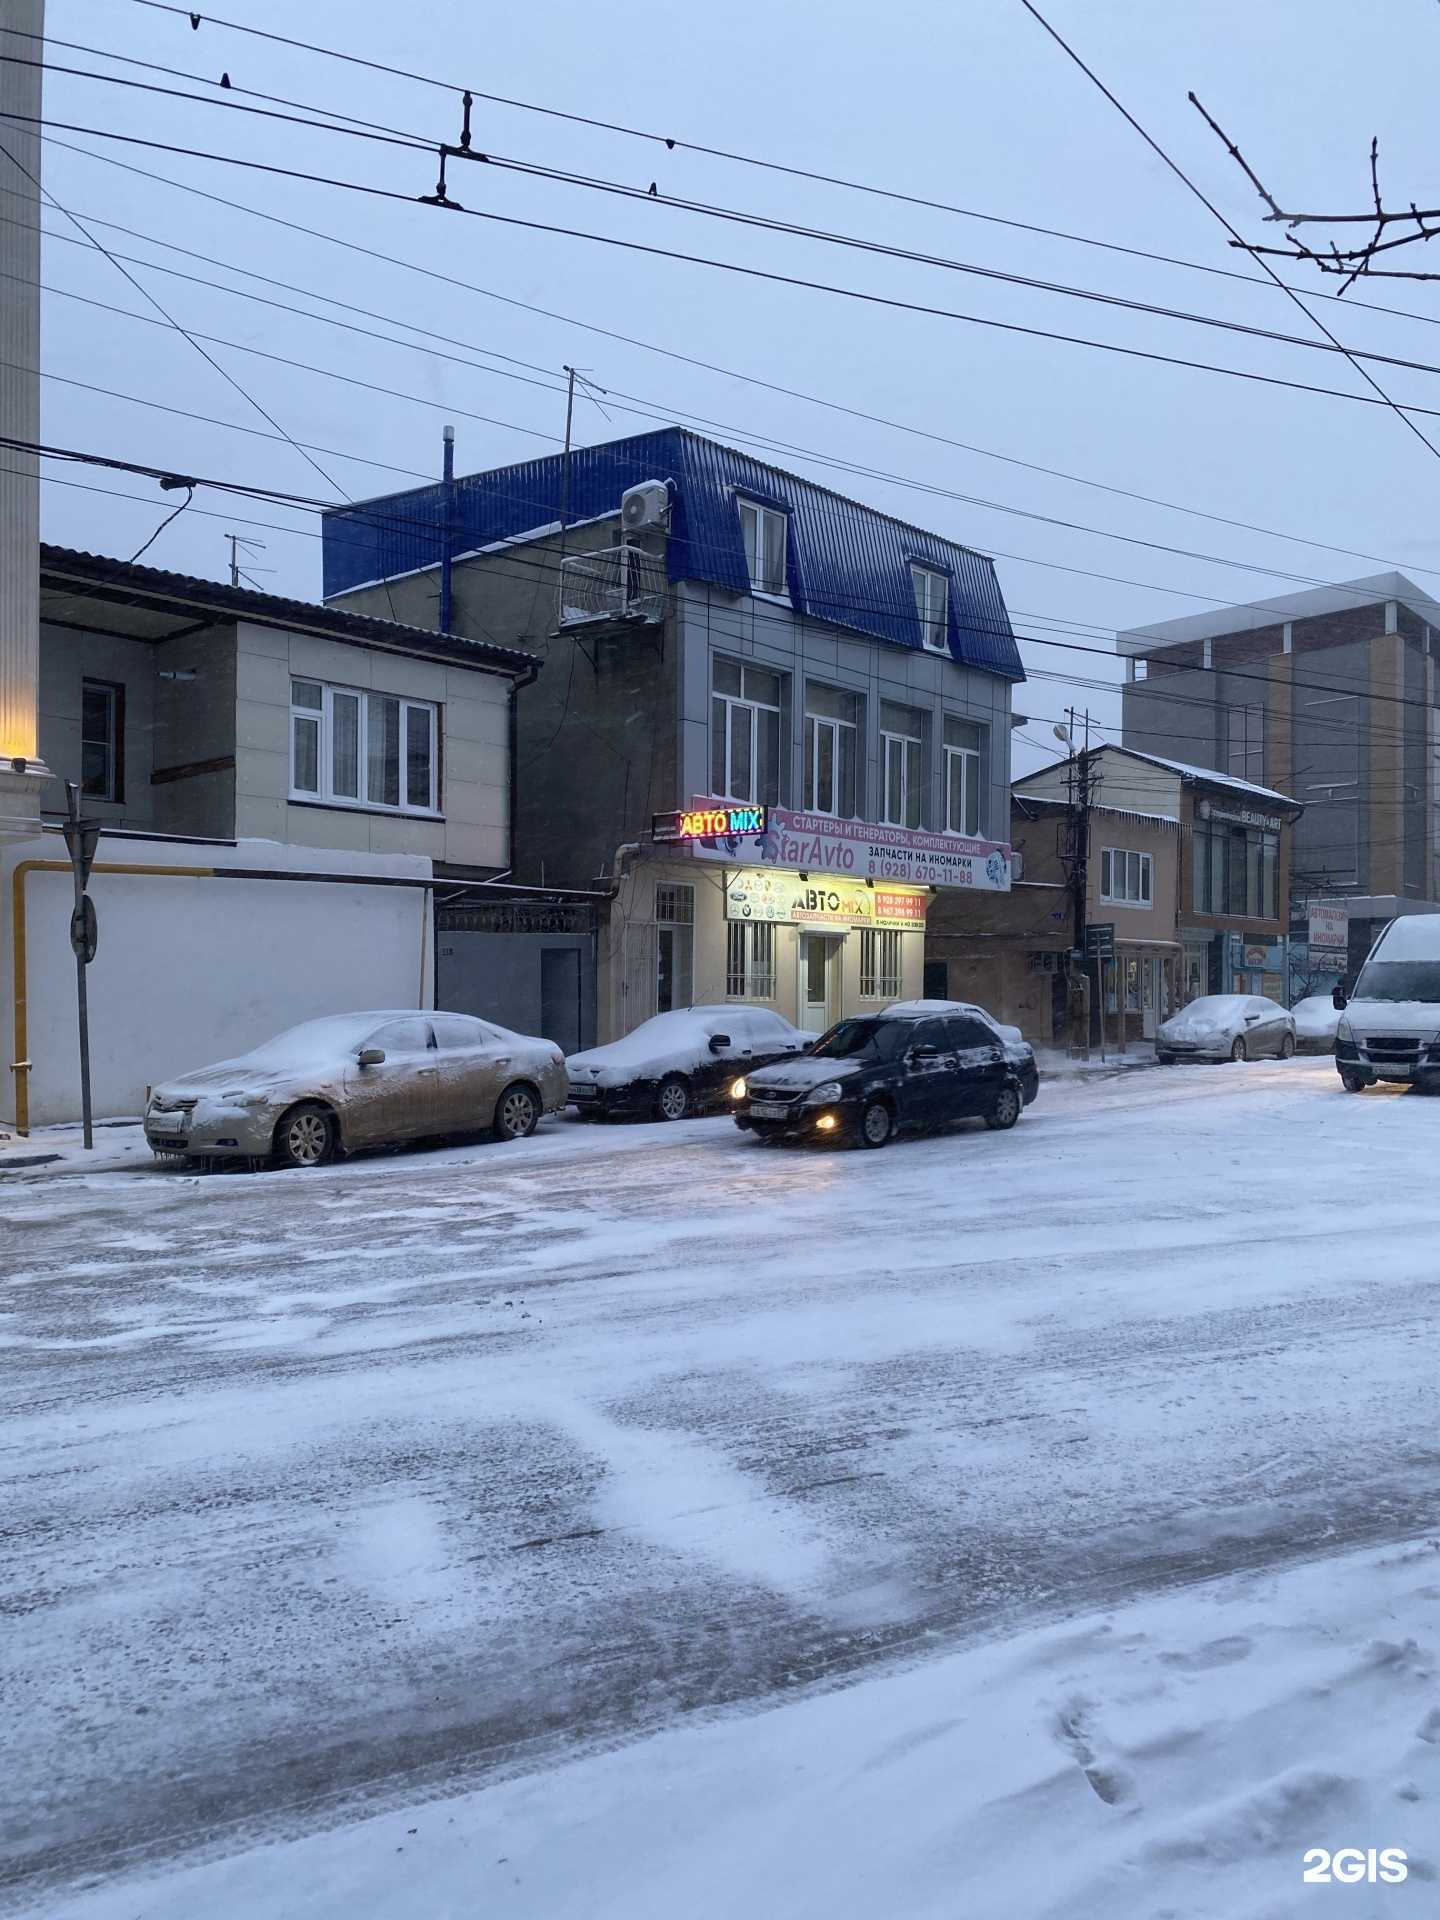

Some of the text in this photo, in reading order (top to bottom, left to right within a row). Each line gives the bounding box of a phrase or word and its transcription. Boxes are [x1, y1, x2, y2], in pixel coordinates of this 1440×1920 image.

[681, 810, 760, 834] АВТО MIX
[792, 816, 981, 853] СТАРТЕРЫ И ГЕНЕРАТОРЫ, КОМПЛЕКТУЮЩИЕ
[868, 846, 972, 869] ЗАПЧАСТИ НА ИНОМАРКИ
[868, 860, 973, 884] 8 (928) 670-11-88
[792, 888, 840, 911] АВТО
